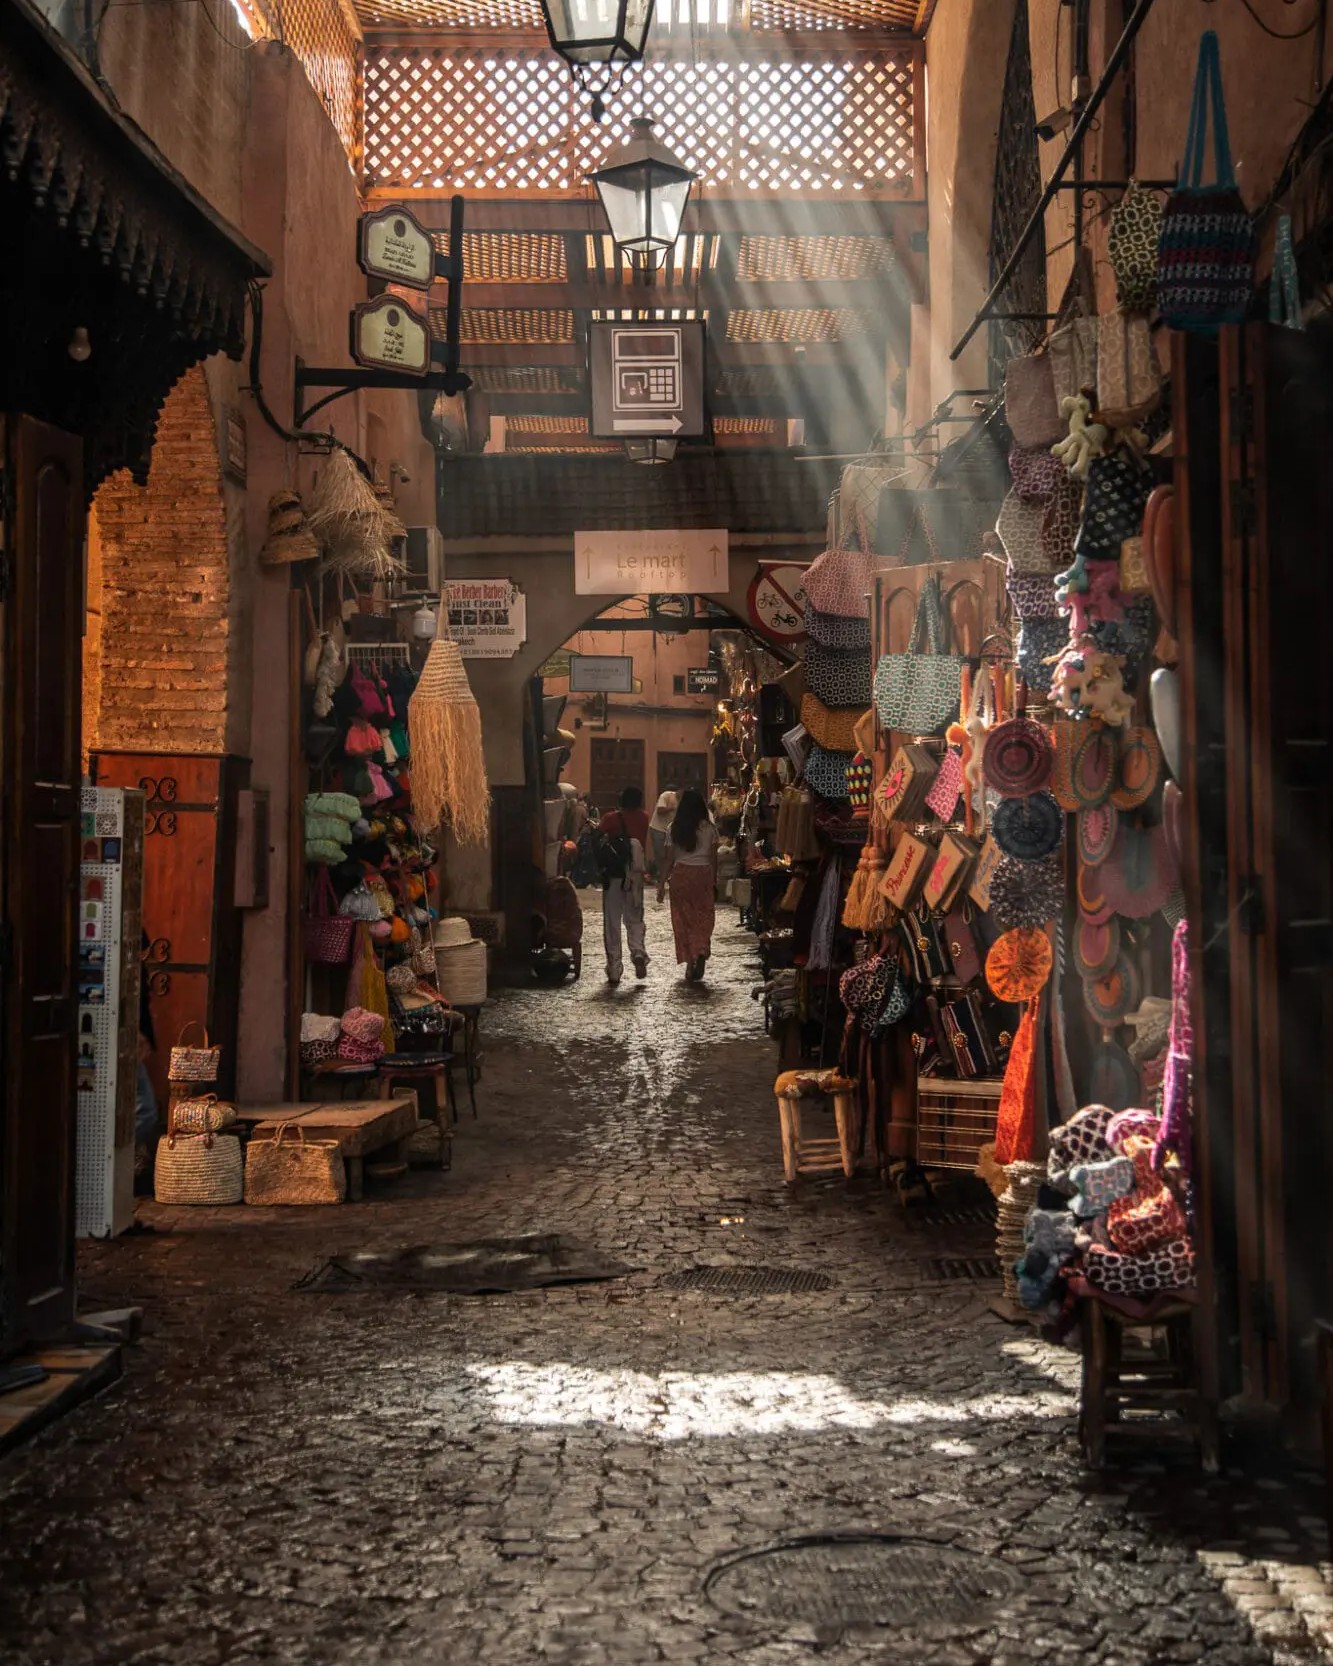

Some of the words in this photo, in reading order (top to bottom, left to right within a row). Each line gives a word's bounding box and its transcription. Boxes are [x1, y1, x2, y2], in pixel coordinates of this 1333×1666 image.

[617, 553, 637, 568] Le
[643, 553, 686, 568] mart
[474, 600, 501, 608] Clean
